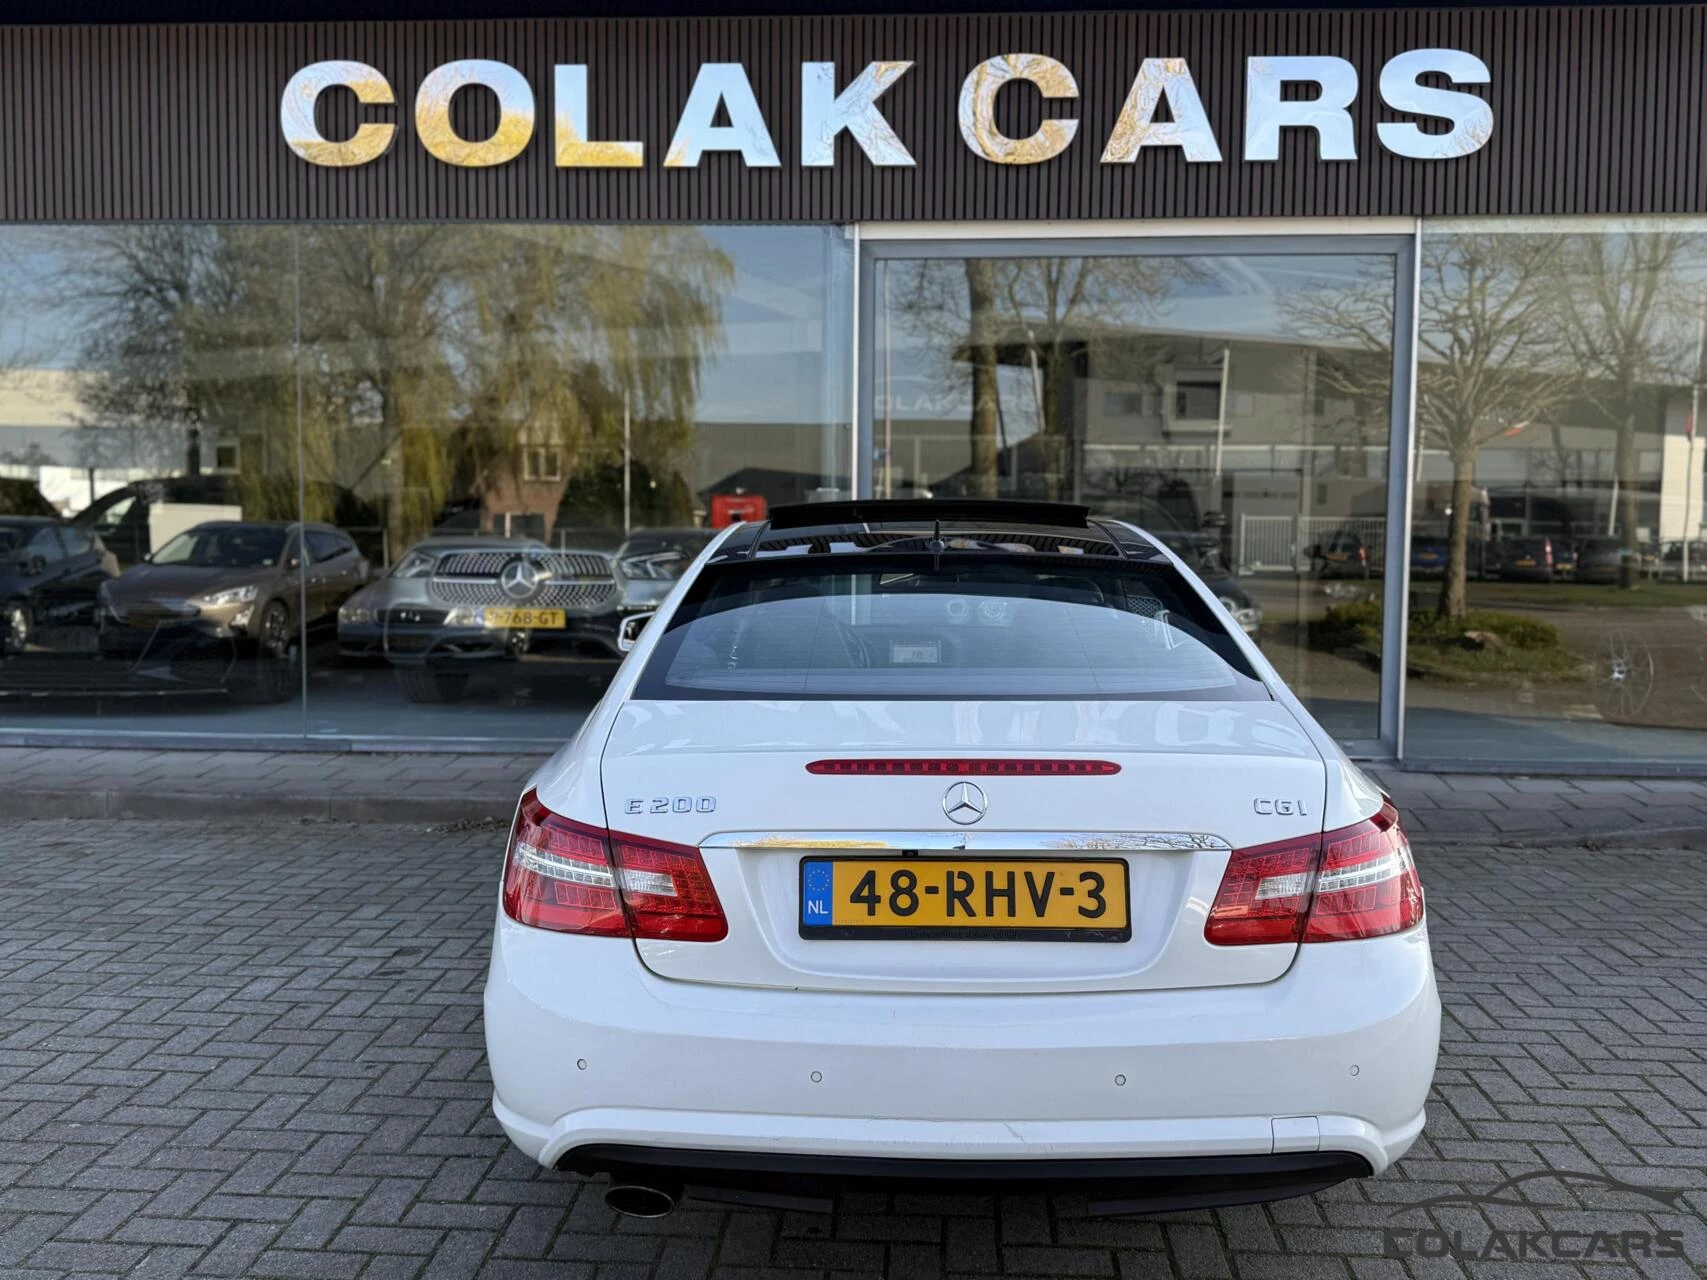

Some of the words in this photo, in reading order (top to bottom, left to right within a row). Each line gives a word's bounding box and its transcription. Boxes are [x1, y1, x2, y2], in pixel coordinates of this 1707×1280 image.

[280, 59, 918, 167] COLAK
[958, 48, 1495, 165] CARS
[624, 798, 644, 815] E
[649, 796, 717, 814] 200
[1253, 797, 1307, 816] CGI
[849, 869, 1107, 919] 48-RHV-3
[807, 899, 829, 915] NL
